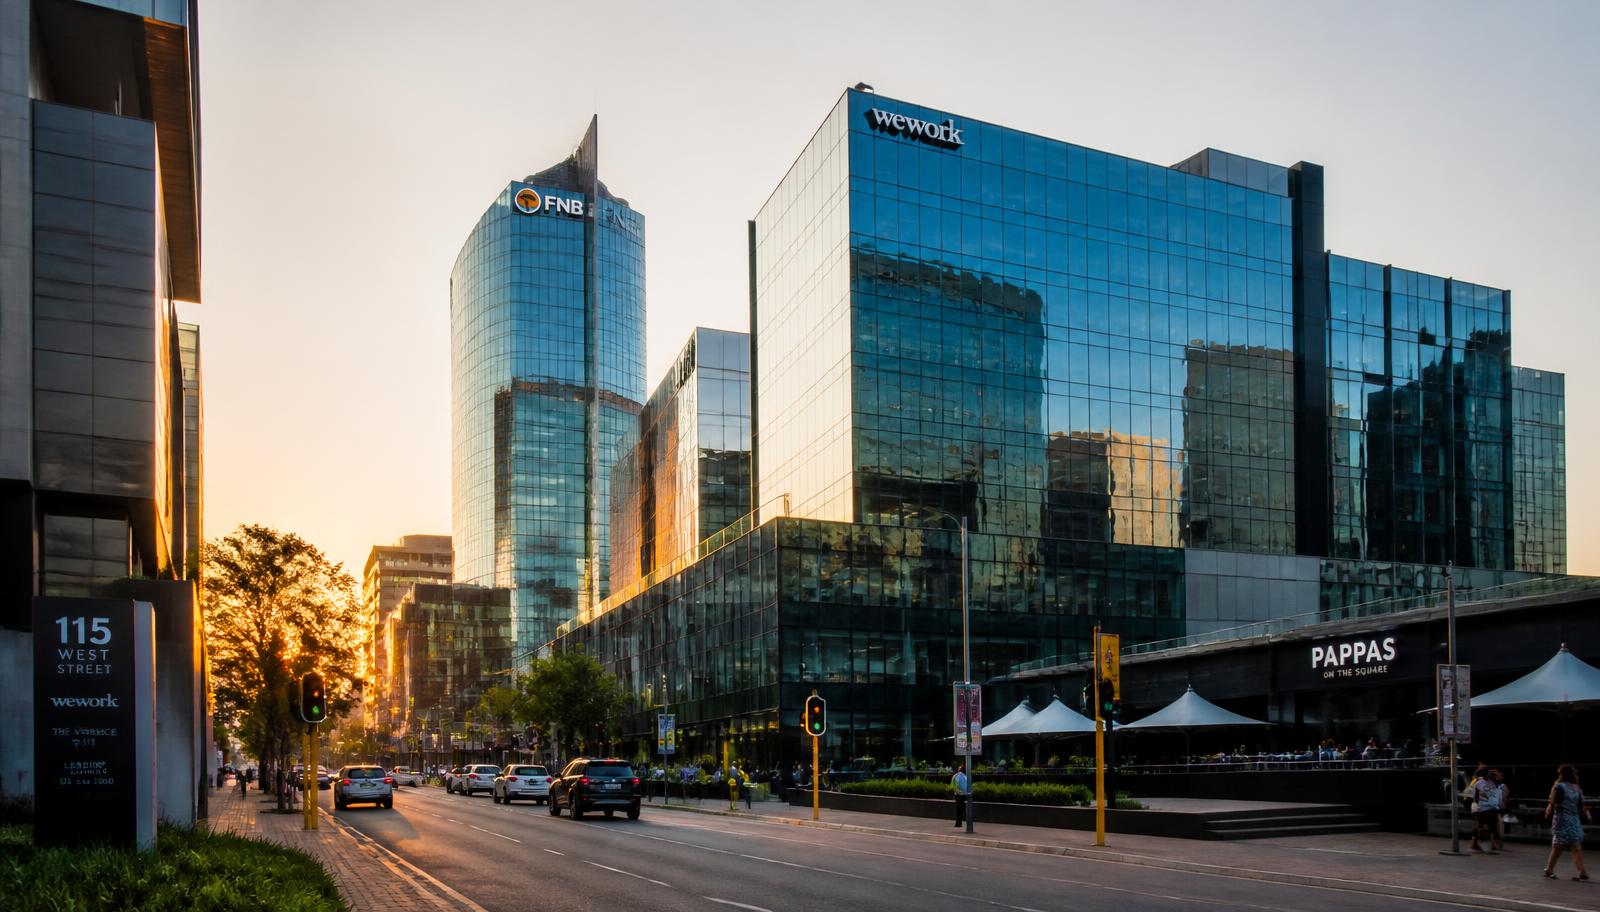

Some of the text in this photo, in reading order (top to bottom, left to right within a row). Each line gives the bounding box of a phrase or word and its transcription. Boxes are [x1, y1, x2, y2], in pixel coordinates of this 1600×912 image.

[871, 107, 965, 145] wework
[544, 195, 583, 215] FNB
[55, 616, 111, 645] 115
[58, 649, 110, 661] WEST
[1312, 637, 1396, 668] PAPPAS
[57, 664, 111, 674] STREET
[1323, 670, 1334, 679] ON
[1338, 669, 1352, 677] THE
[50, 693, 119, 708] wework
